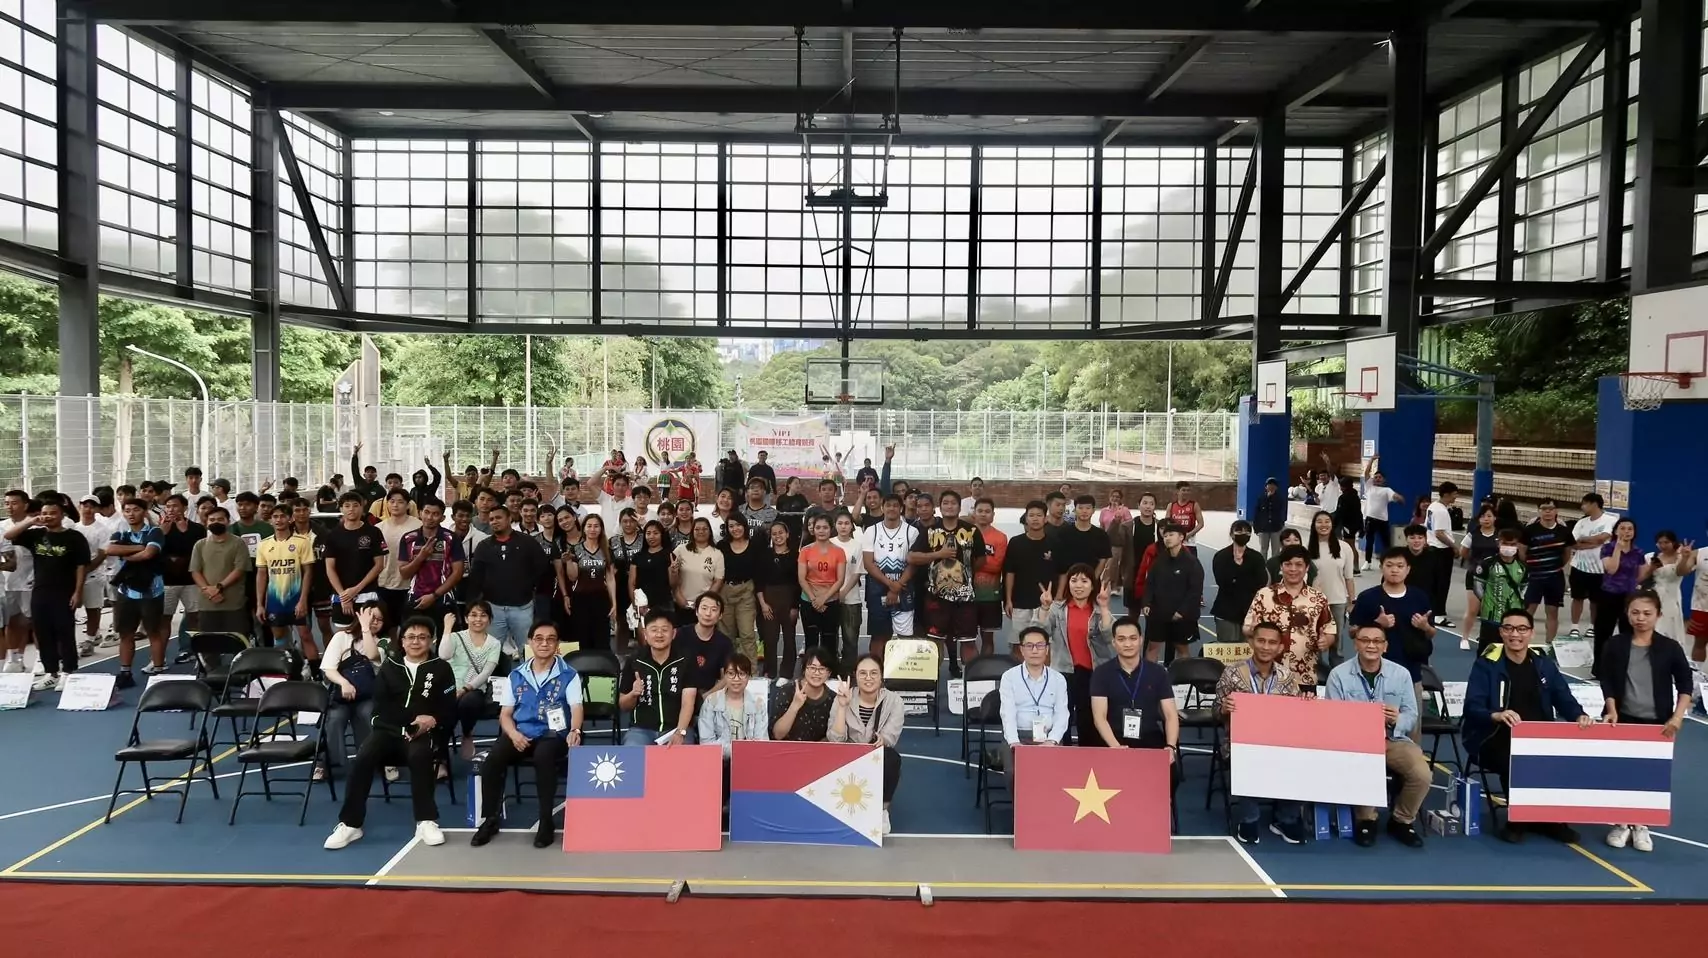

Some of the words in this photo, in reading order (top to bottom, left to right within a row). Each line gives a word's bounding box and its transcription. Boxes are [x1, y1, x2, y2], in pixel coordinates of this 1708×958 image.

[657, 437, 685, 452] 桃園
[888, 543, 894, 552] 3
[583, 559, 604, 567] PHTW
[817, 561, 829, 572] 03
[590, 568, 596, 577] 2
[421, 672, 434, 698] 勞動局
[669, 667, 678, 692] 勞動局
